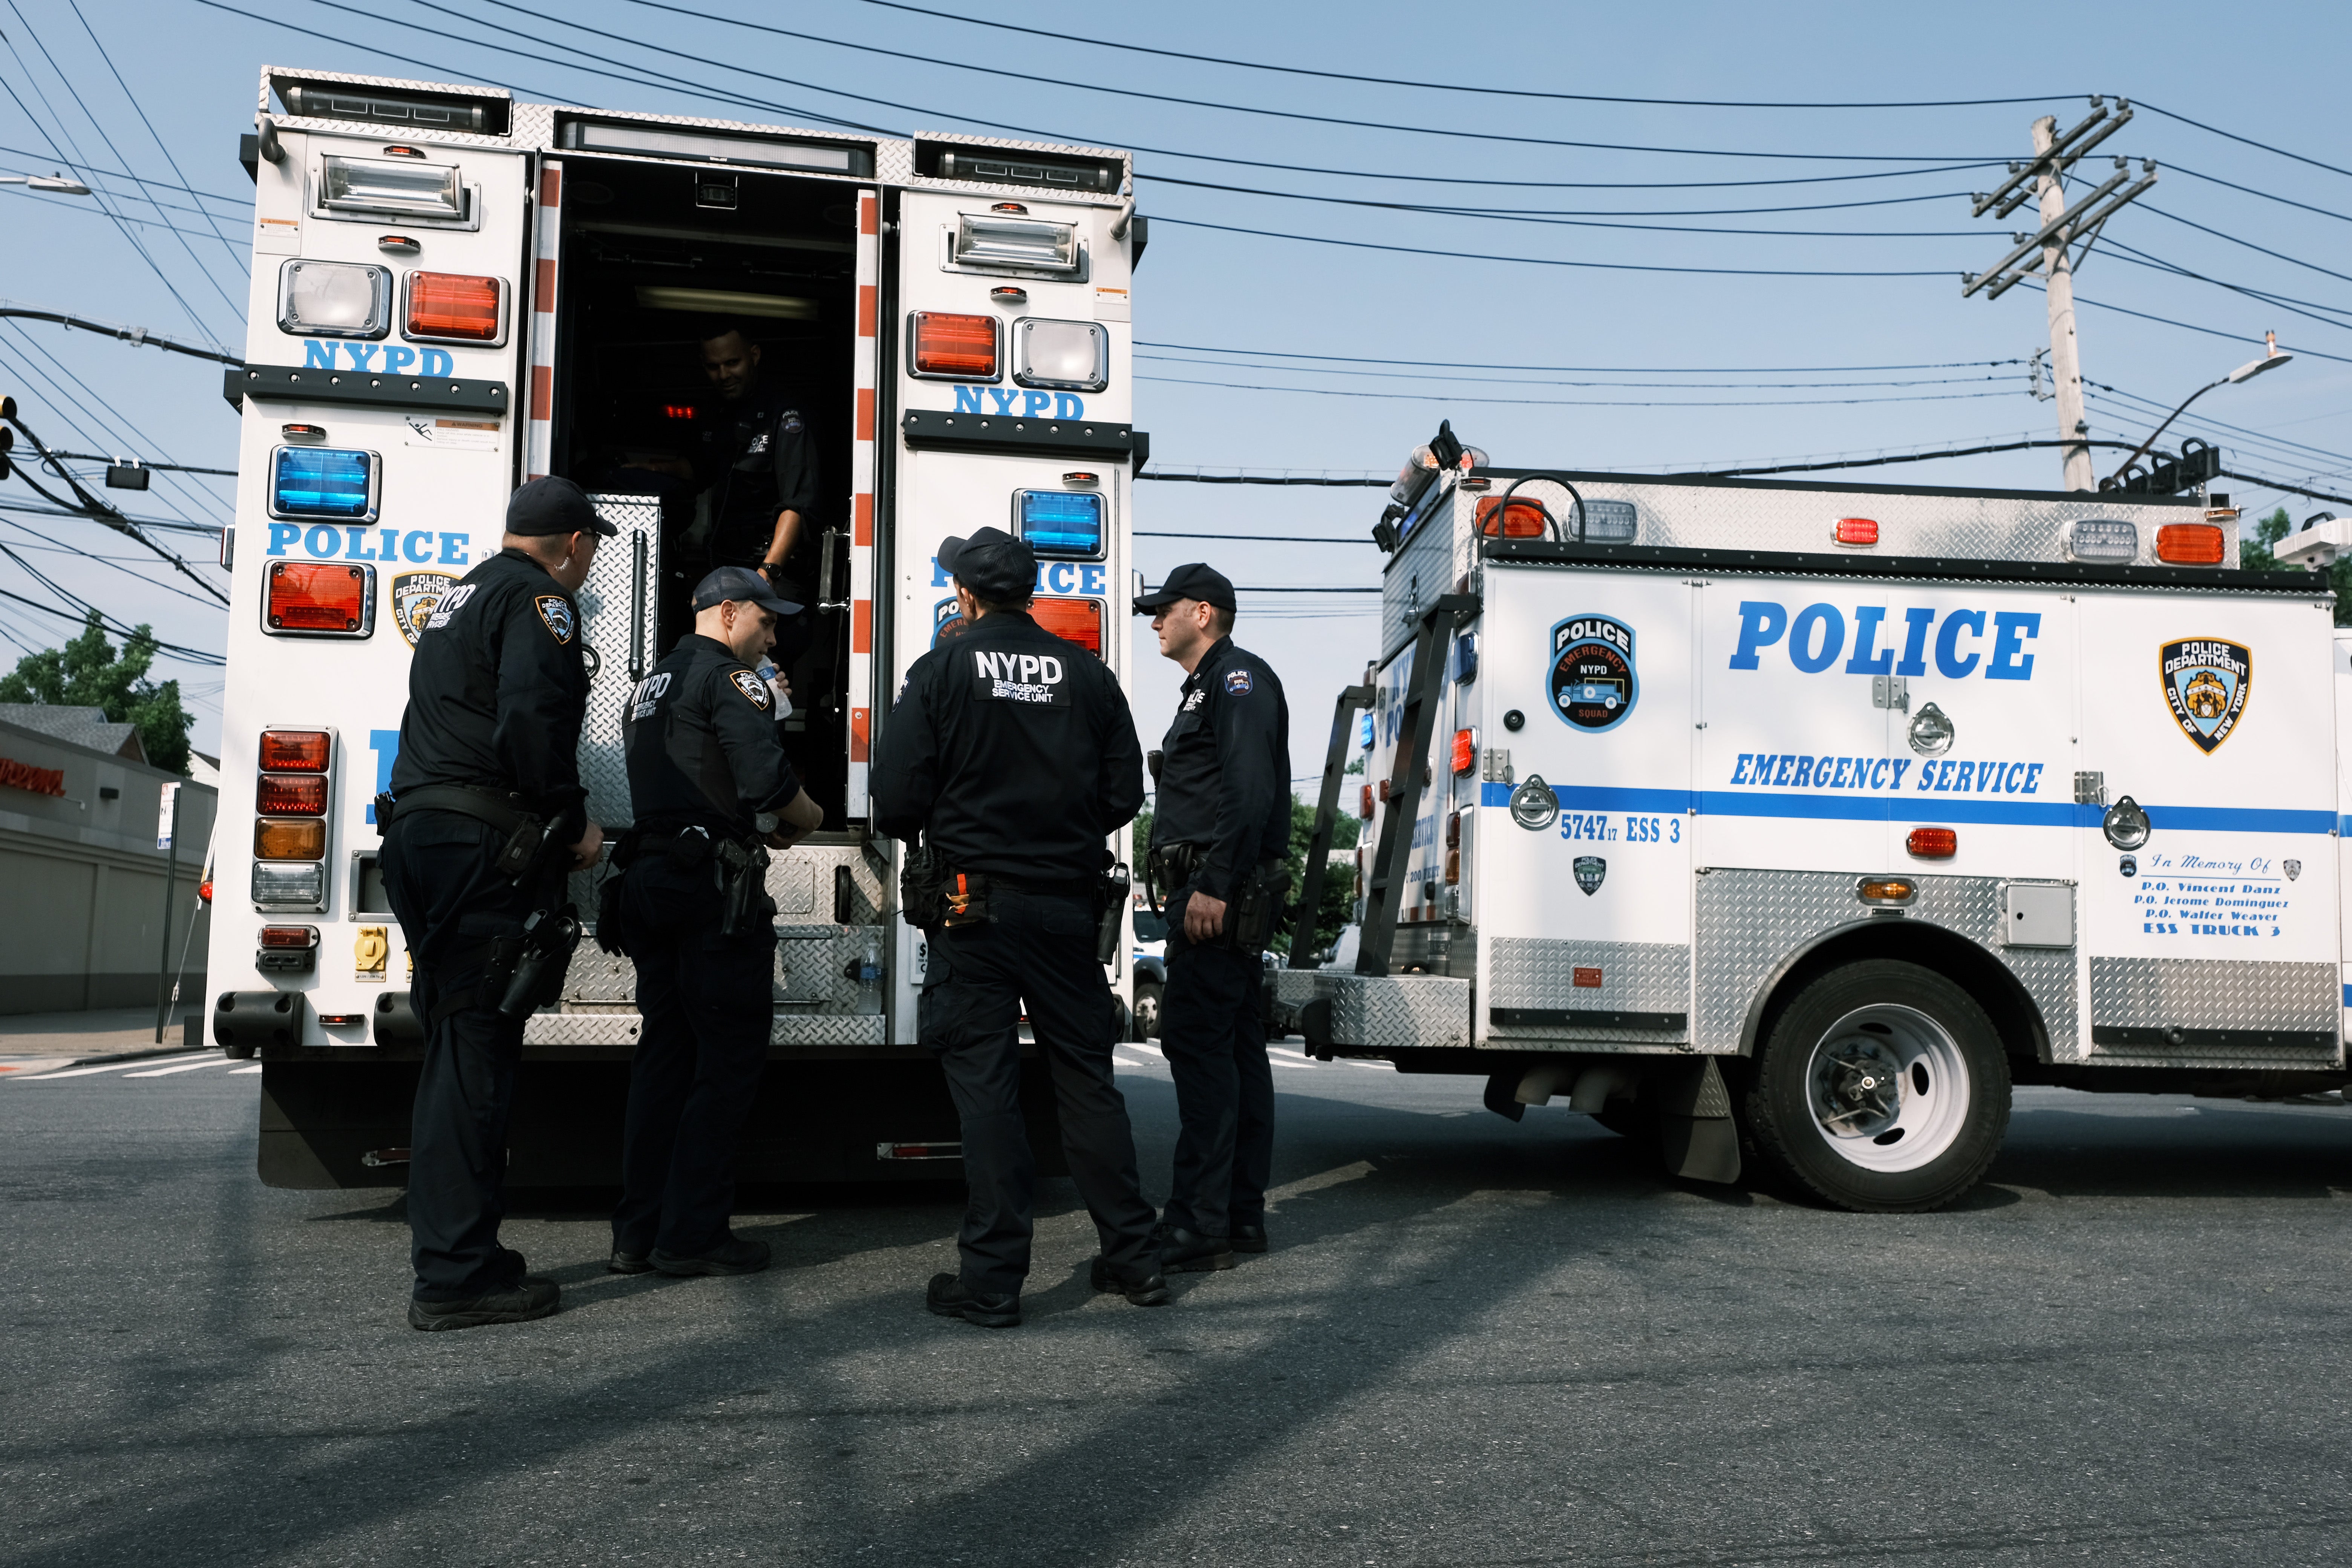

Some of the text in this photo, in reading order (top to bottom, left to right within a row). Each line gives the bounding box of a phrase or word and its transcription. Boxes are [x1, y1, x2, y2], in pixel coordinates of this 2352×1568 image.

[303, 340, 453, 378] NYPD
[954, 385, 1084, 421] NYPD
[266, 523, 469, 565] POLICE
[410, 575, 451, 586] POLICE
[931, 557, 1106, 594] PICE
[395, 584, 452, 599] DEPARTM
[396, 608, 418, 643] CITY OF
[544, 613, 553, 625] CITY
[1557, 620, 1629, 652] POLICE
[1729, 601, 2041, 680] POLICE
[1559, 646, 1627, 673] EMERGENCY
[2182, 642, 2230, 657] POLICE
[975, 651, 1062, 684] NYPD
[1580, 665, 1607, 675] NYPD
[2165, 654, 2246, 676] DEPARTMENT
[994, 679, 1049, 694] EMERGENCY
[1227, 671, 1248, 681] POLICE
[631, 672, 672, 706] NYPD
[992, 688, 1053, 702] SERVICE UNIT
[1579, 709, 1608, 718] SQUAD
[2167, 687, 2197, 733] CITY OF
[2214, 683, 2247, 741] NEW YORK
[1730, 754, 2043, 794] EMERGENCY SERVICE
[1561, 814, 1680, 843] 5747 17 ESS 3
[1410, 870, 1421, 882] 200
[1424, 865, 1440, 880] FEET
[2151, 854, 2271, 875] In Memory Of
[2142, 882, 2280, 894] P.O. Vincent Danz
[2135, 895, 2288, 909] P.O. Jerome Dominguez
[2146, 909, 2278, 921] P.O. Walter Weaver
[2144, 923, 2280, 936] ESS TRUCK 3
